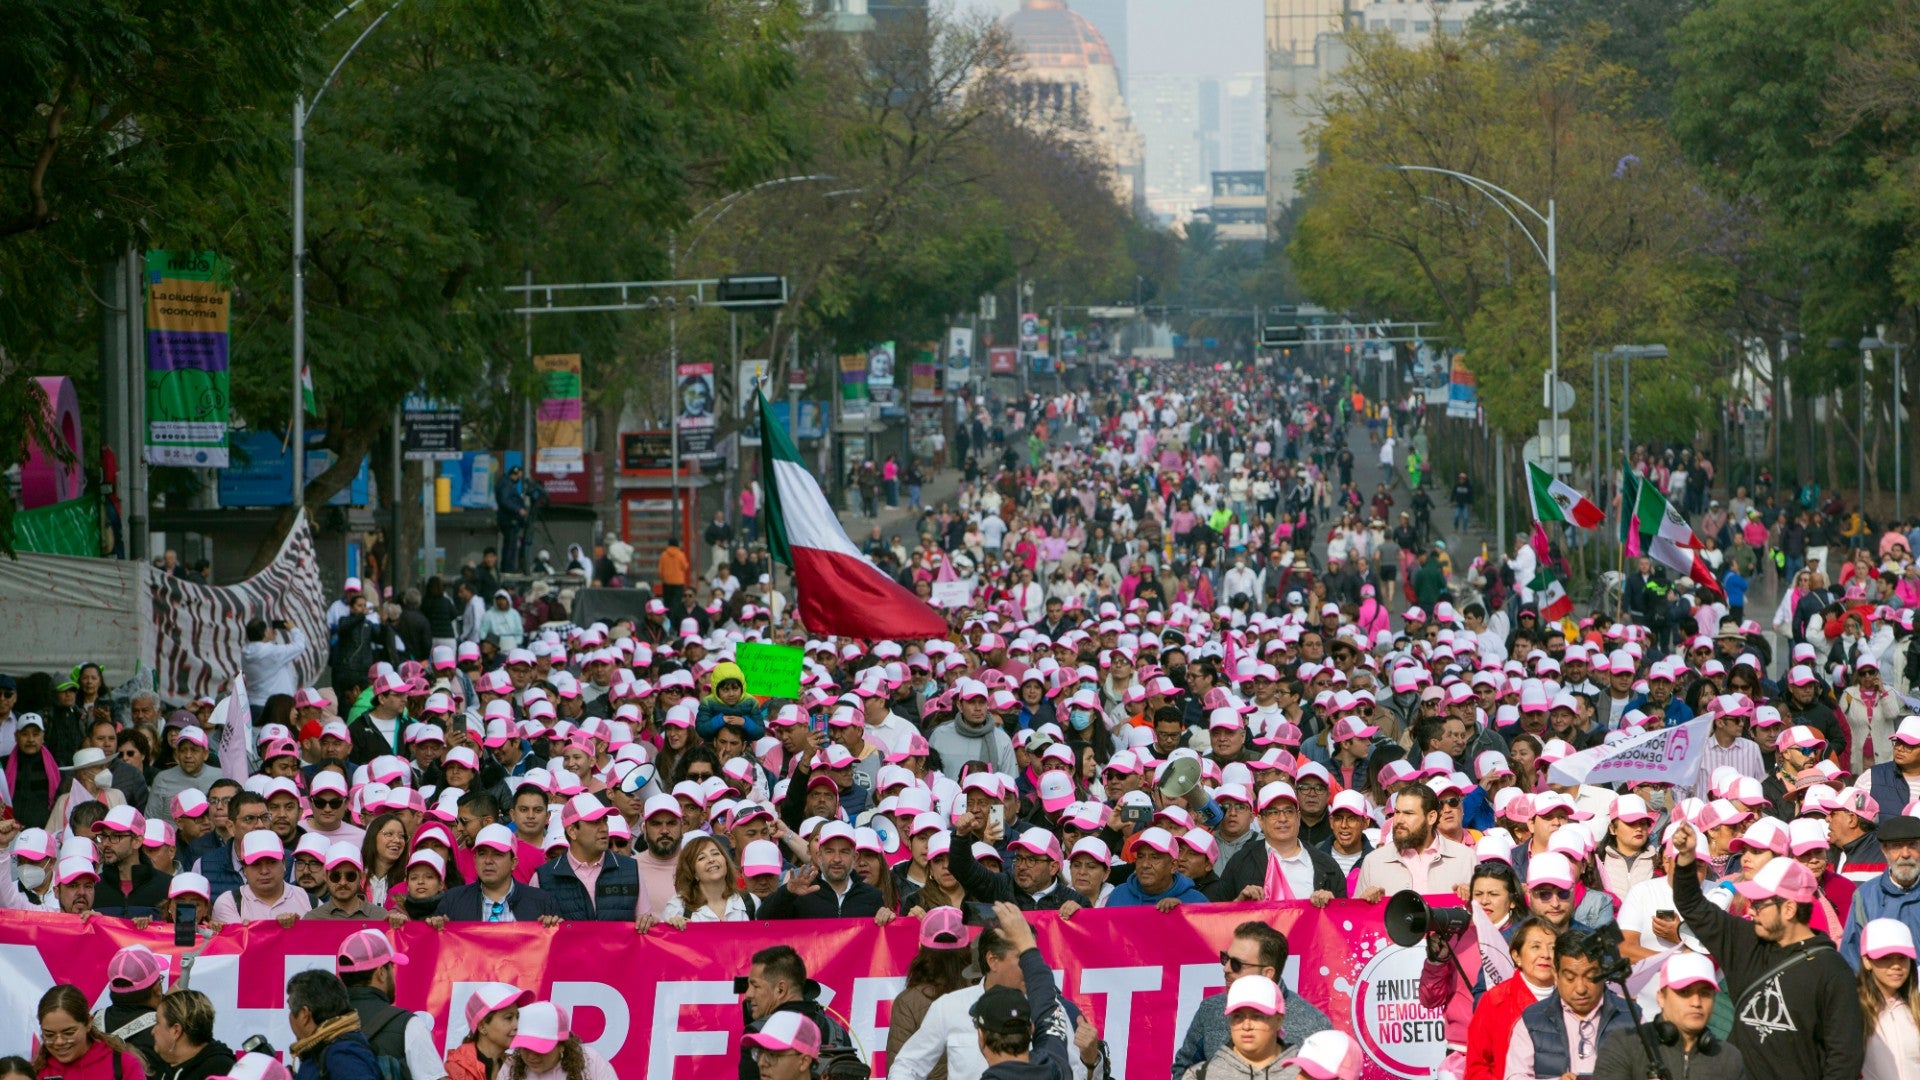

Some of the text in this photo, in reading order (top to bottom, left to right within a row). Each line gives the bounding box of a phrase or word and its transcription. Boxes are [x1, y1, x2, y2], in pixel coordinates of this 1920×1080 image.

[152, 291, 223, 305] La ciudad es
[160, 307, 217, 319] economía
[1376, 979, 1421, 1001] #NUE
[1377, 1003, 1446, 1021] DEMOCRA
